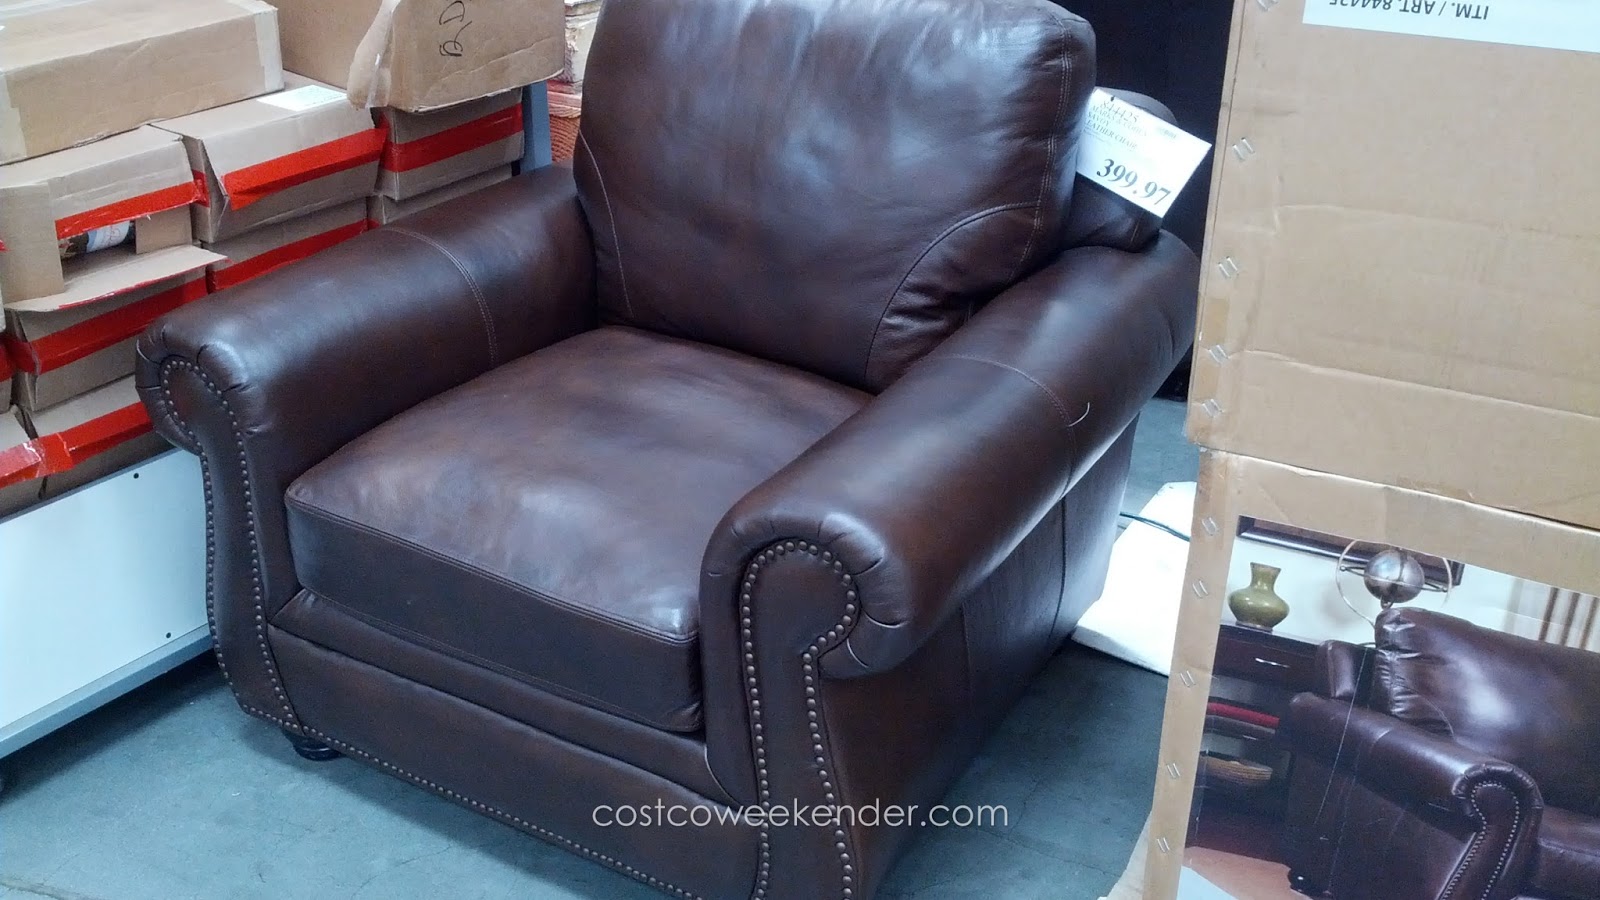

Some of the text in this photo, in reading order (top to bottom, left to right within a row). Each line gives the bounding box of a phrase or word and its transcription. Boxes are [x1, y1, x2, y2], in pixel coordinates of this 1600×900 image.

[1398, 0, 1436, 15] ART.
[1451, 2, 1490, 20] ITM.
[1085, 119, 1115, 138] EATHER
[1096, 158, 1172, 206] 399.97
